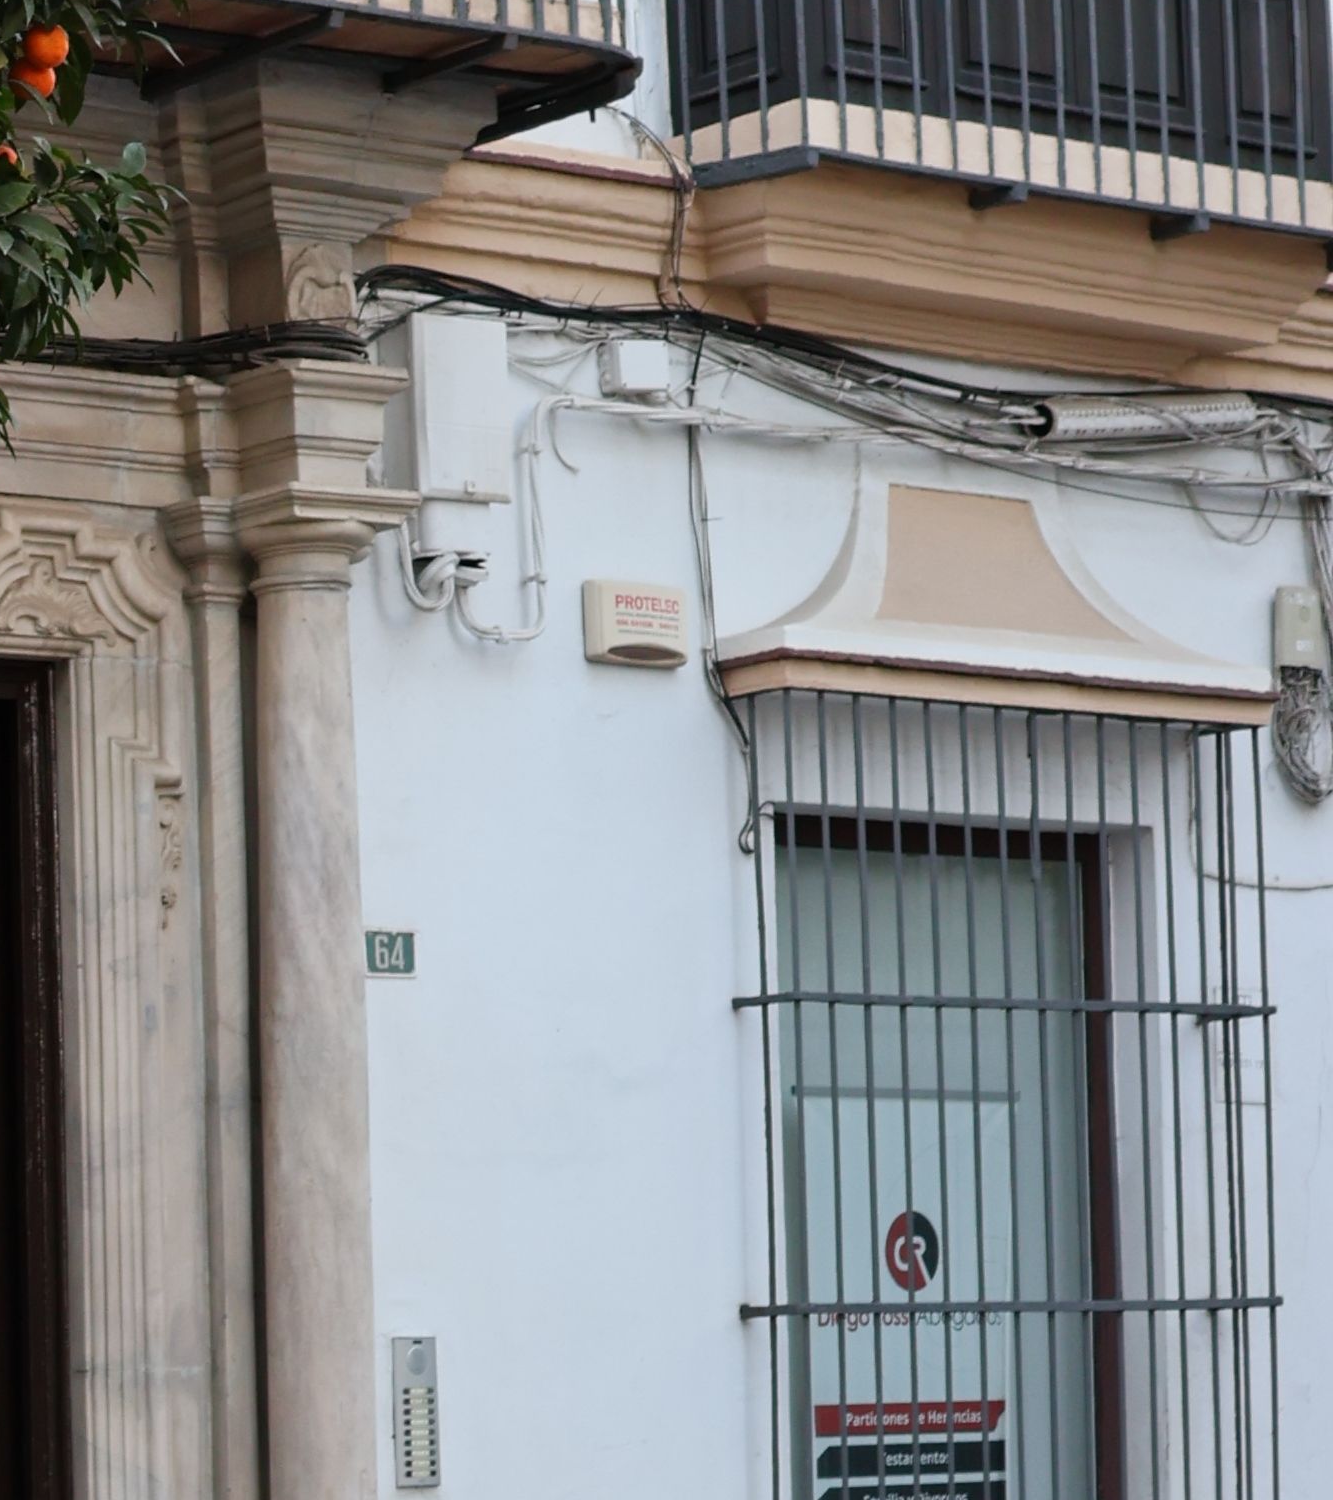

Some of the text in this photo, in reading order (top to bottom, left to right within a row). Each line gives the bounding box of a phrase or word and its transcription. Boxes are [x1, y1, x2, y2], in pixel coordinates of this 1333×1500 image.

[615, 595, 679, 614] PROTELEC
[375, 935, 405, 970] 64
[818, 1308, 870, 1332] Digo
[846, 1410, 910, 1427] Particones
[928, 1408, 982, 1426] Herncias
